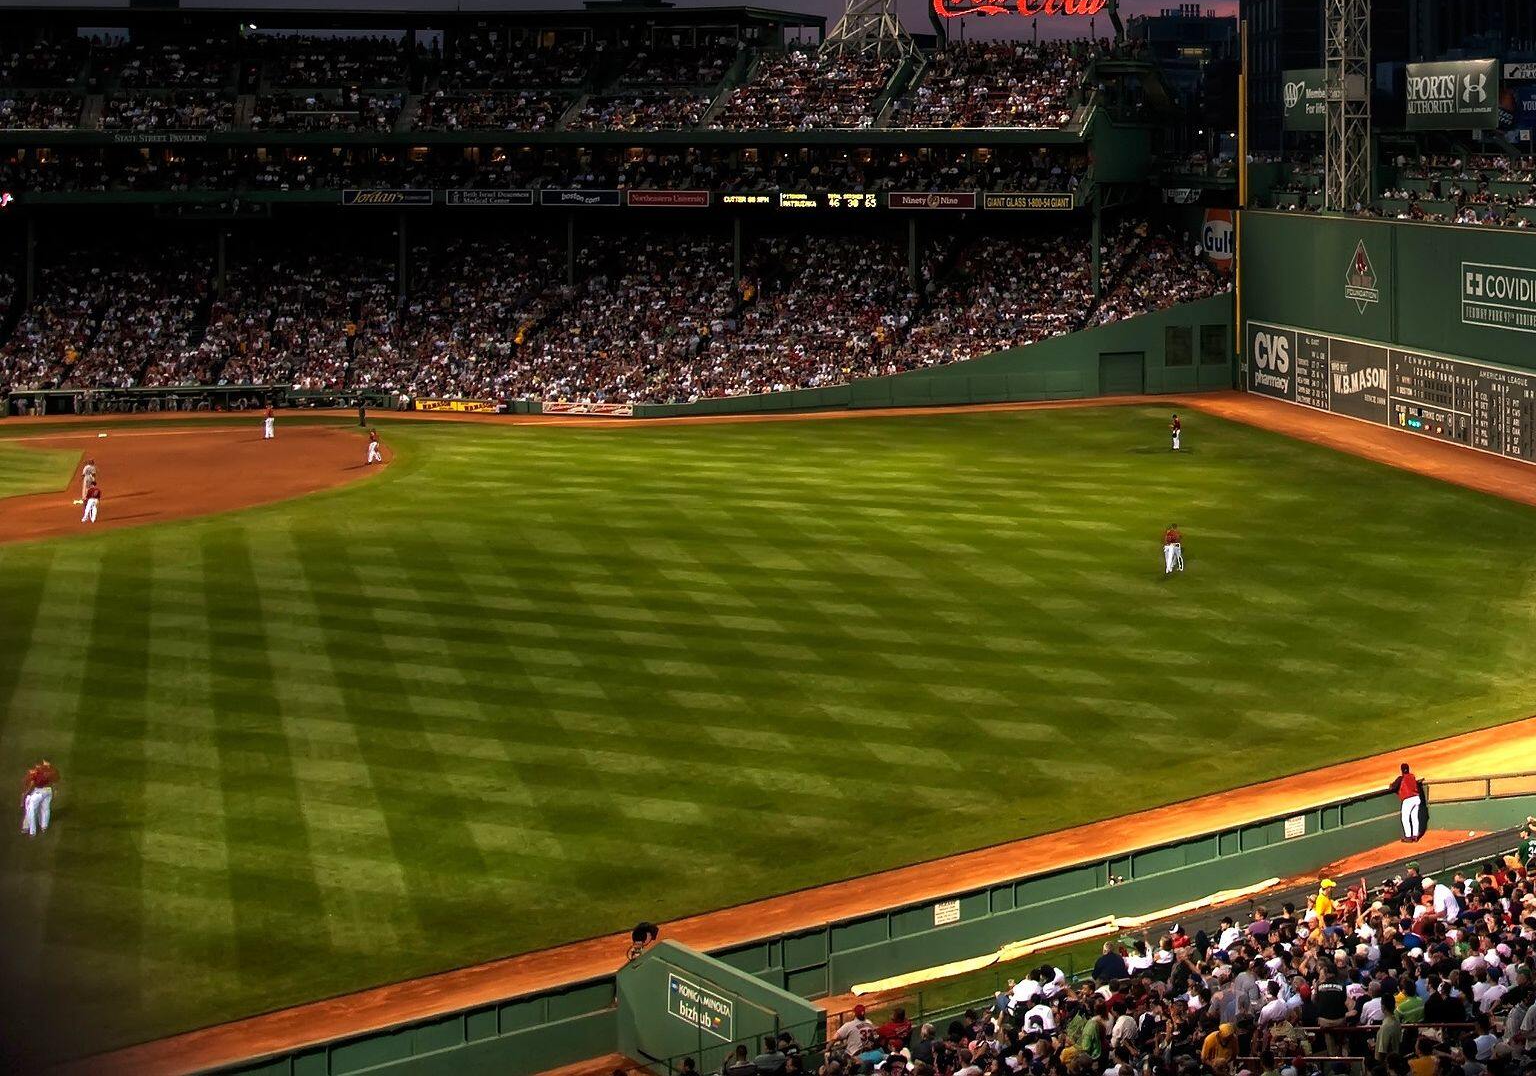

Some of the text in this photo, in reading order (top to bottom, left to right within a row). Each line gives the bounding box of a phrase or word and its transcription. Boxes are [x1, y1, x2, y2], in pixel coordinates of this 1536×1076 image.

[1407, 75, 1455, 99] SPORTS
[1407, 100, 1455, 114] AUTHORITY
[114, 134, 207, 143] STATE STREET PAVILION
[902, 196, 926, 205] Ninety
[987, 197, 1005, 208] GIANT
[1006, 197, 1026, 208] GLASS
[1347, 289, 1377, 299] FOUNDATION
[1254, 331, 1289, 374] CVS
[1404, 355, 1454, 372] FENWAY PARK
[1254, 370, 1289, 394] pharmacy
[1480, 370, 1528, 387] AMERICAN LEAGUE
[678, 984, 731, 1017] KONICA MINOLTA
[679, 1000, 711, 1027] bizhub
